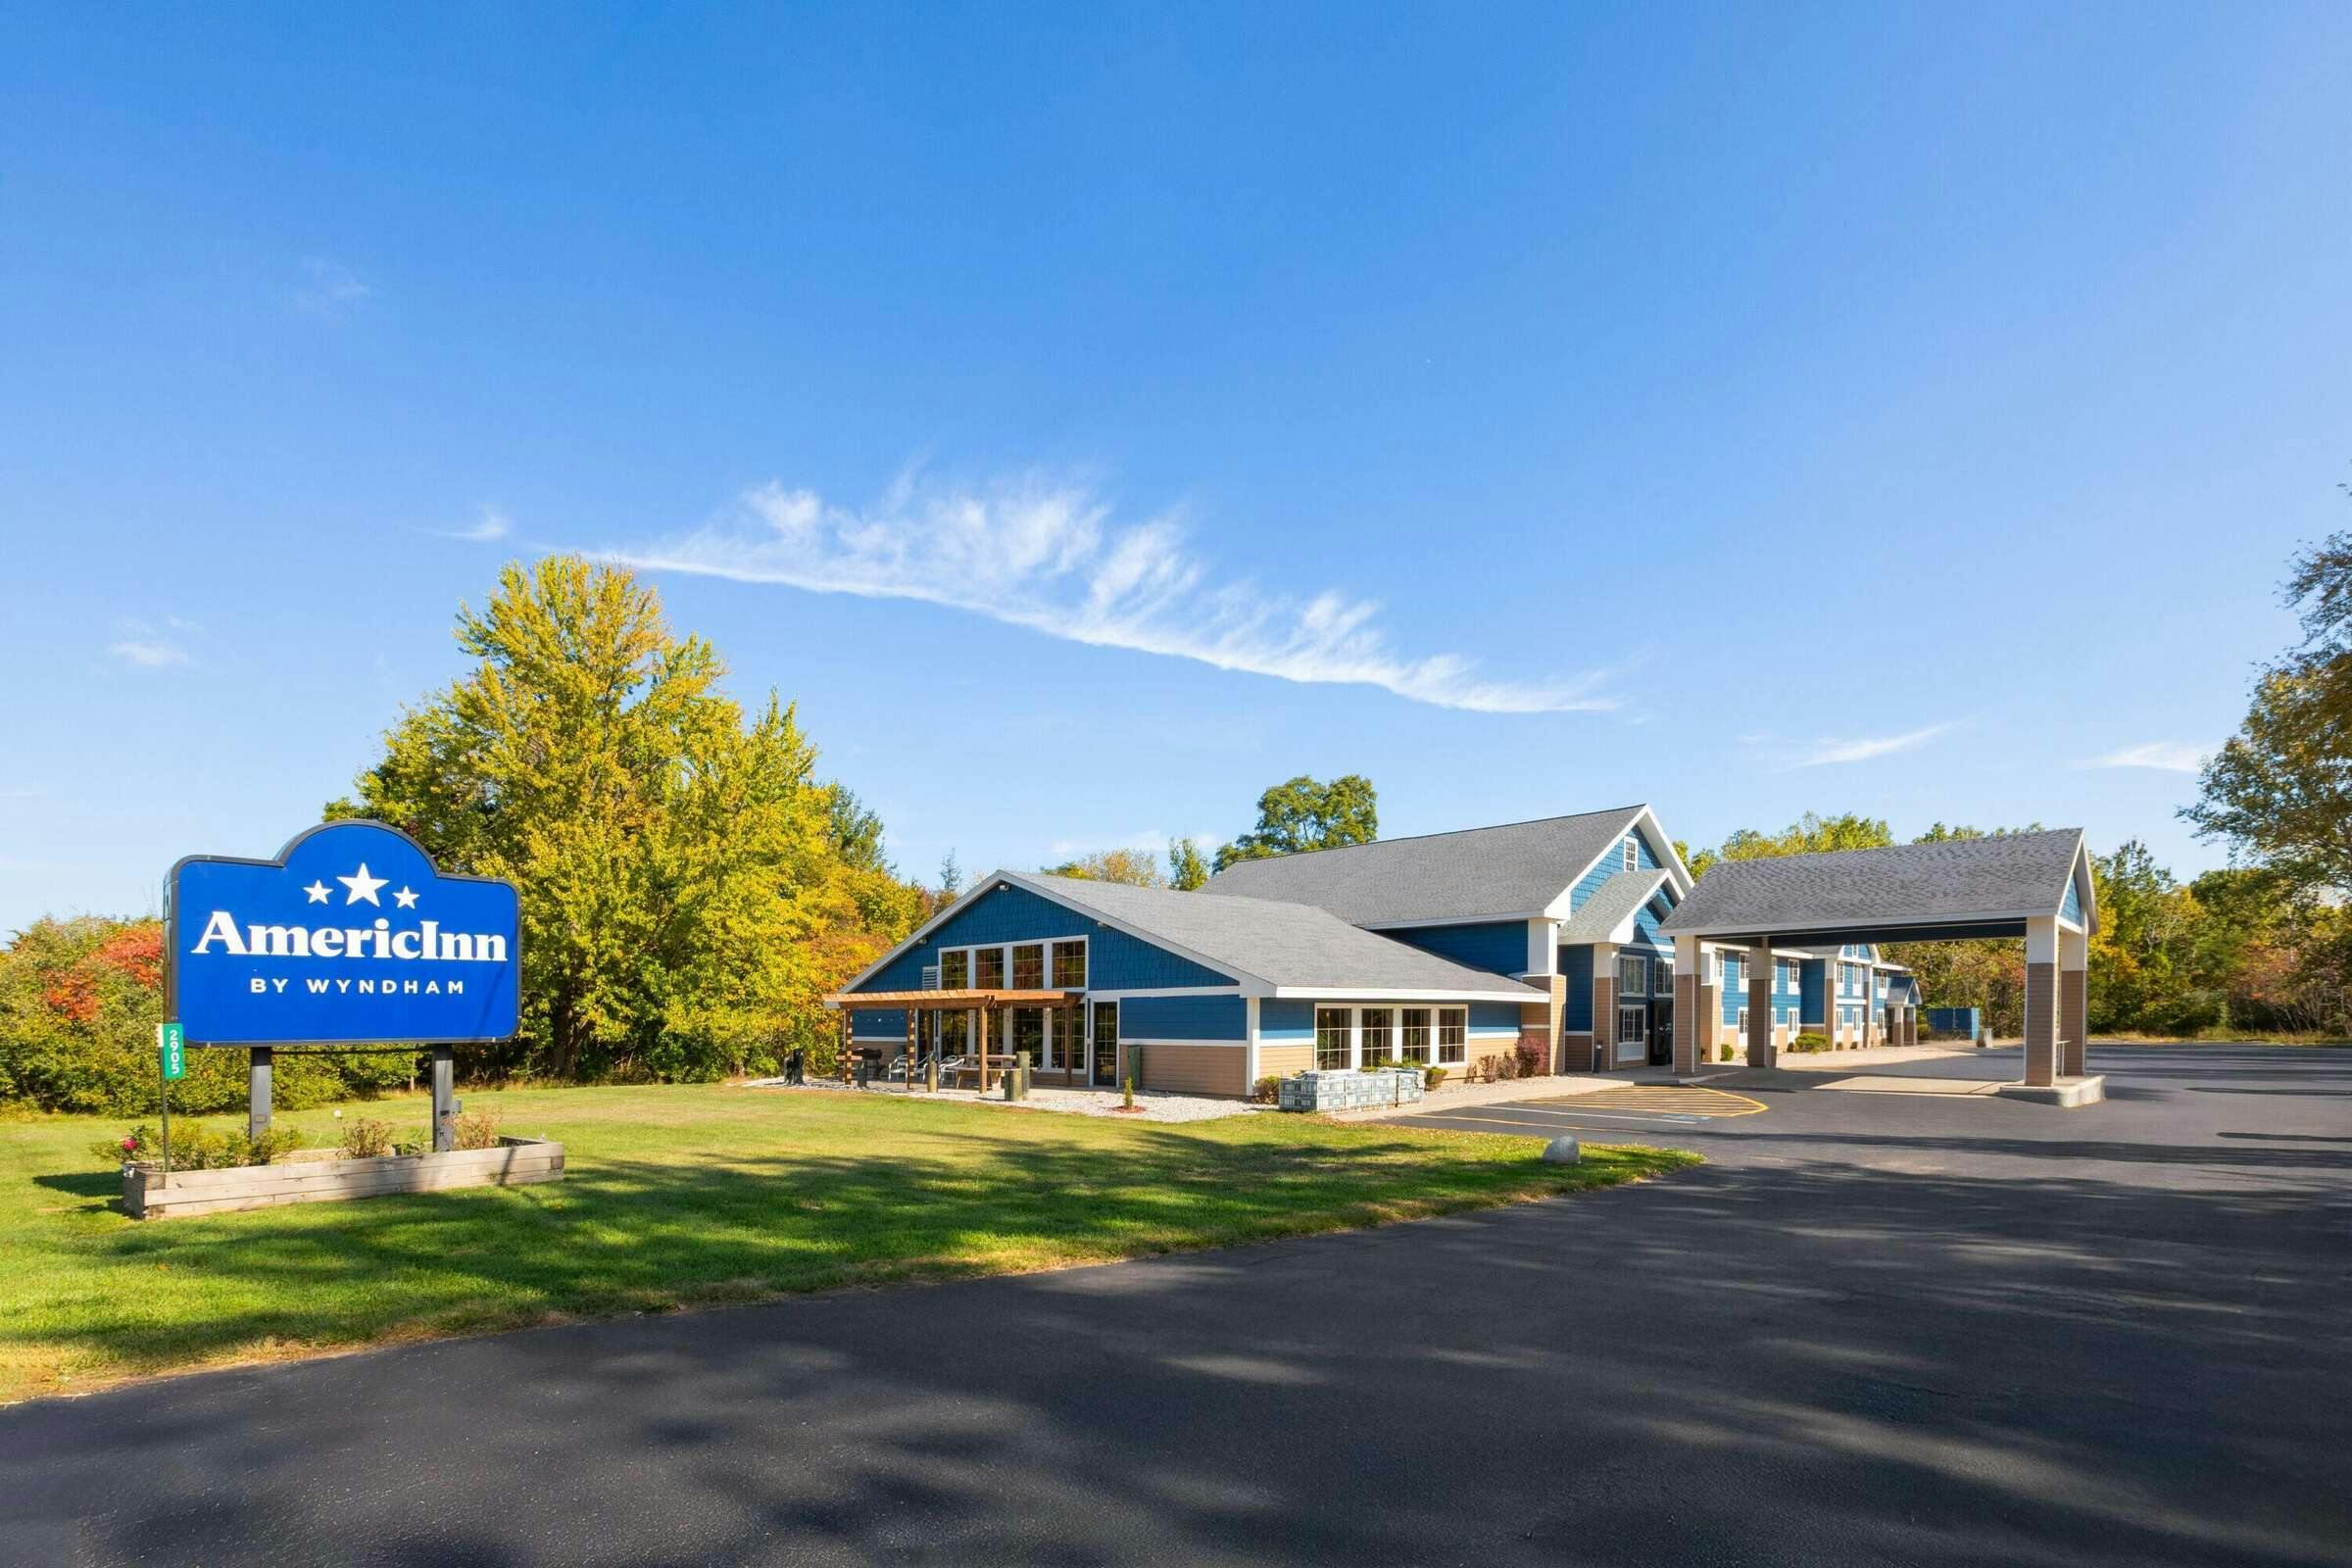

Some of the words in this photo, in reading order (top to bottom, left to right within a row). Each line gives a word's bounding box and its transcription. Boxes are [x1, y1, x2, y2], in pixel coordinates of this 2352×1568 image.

[191, 910, 508, 961] AmericInn
[250, 978, 288, 994] BY
[306, 979, 465, 995] WYNDHAM
[170, 1029, 180, 1074] 2905
